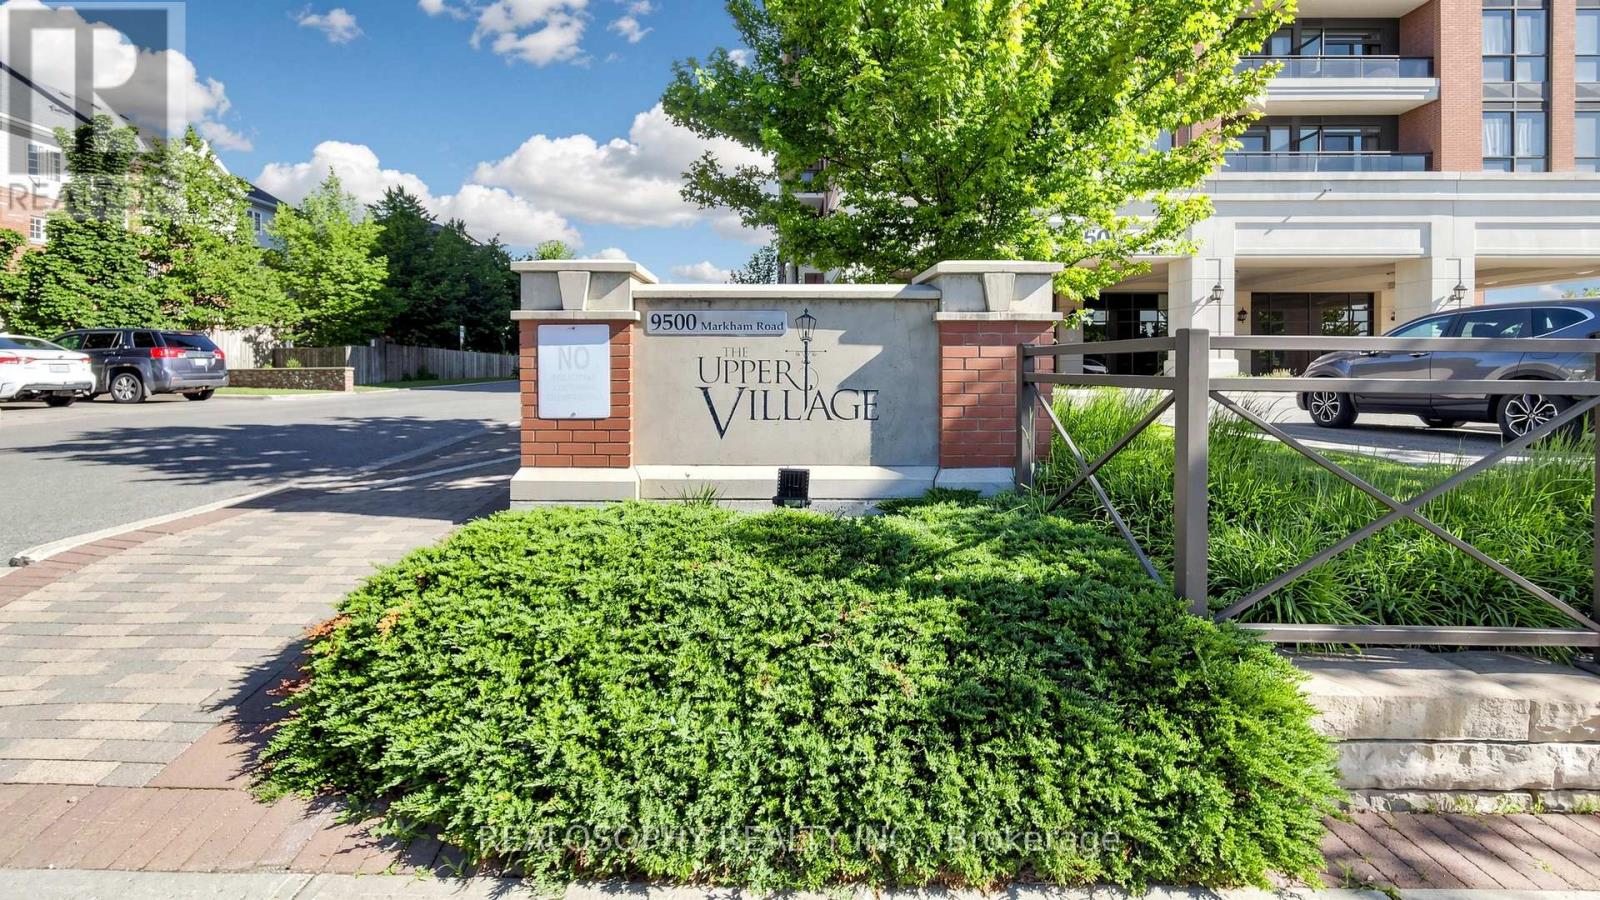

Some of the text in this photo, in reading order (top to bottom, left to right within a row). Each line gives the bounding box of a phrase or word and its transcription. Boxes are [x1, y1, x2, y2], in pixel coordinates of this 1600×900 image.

[650, 313, 784, 331] 9500 Markham Road
[558, 346, 590, 371] NO
[723, 346, 749, 358] THE
[697, 356, 806, 391] UPPER
[695, 386, 880, 440] VILLAGE
